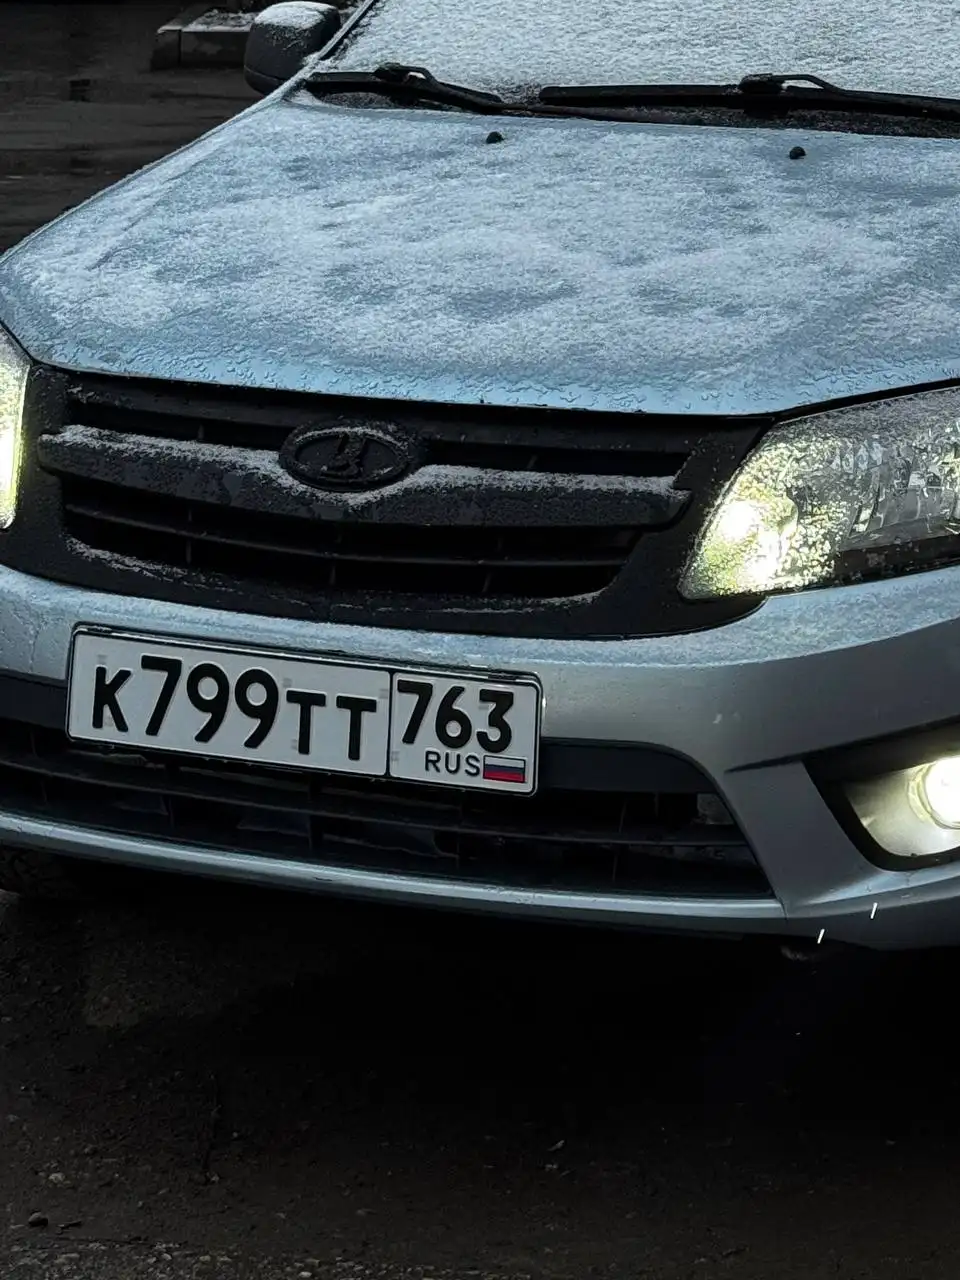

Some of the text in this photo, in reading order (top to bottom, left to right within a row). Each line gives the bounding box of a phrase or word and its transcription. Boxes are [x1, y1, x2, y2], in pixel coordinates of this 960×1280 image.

[91, 654, 515, 761] К799ТТ 763
[424, 751, 481, 777] RUS
